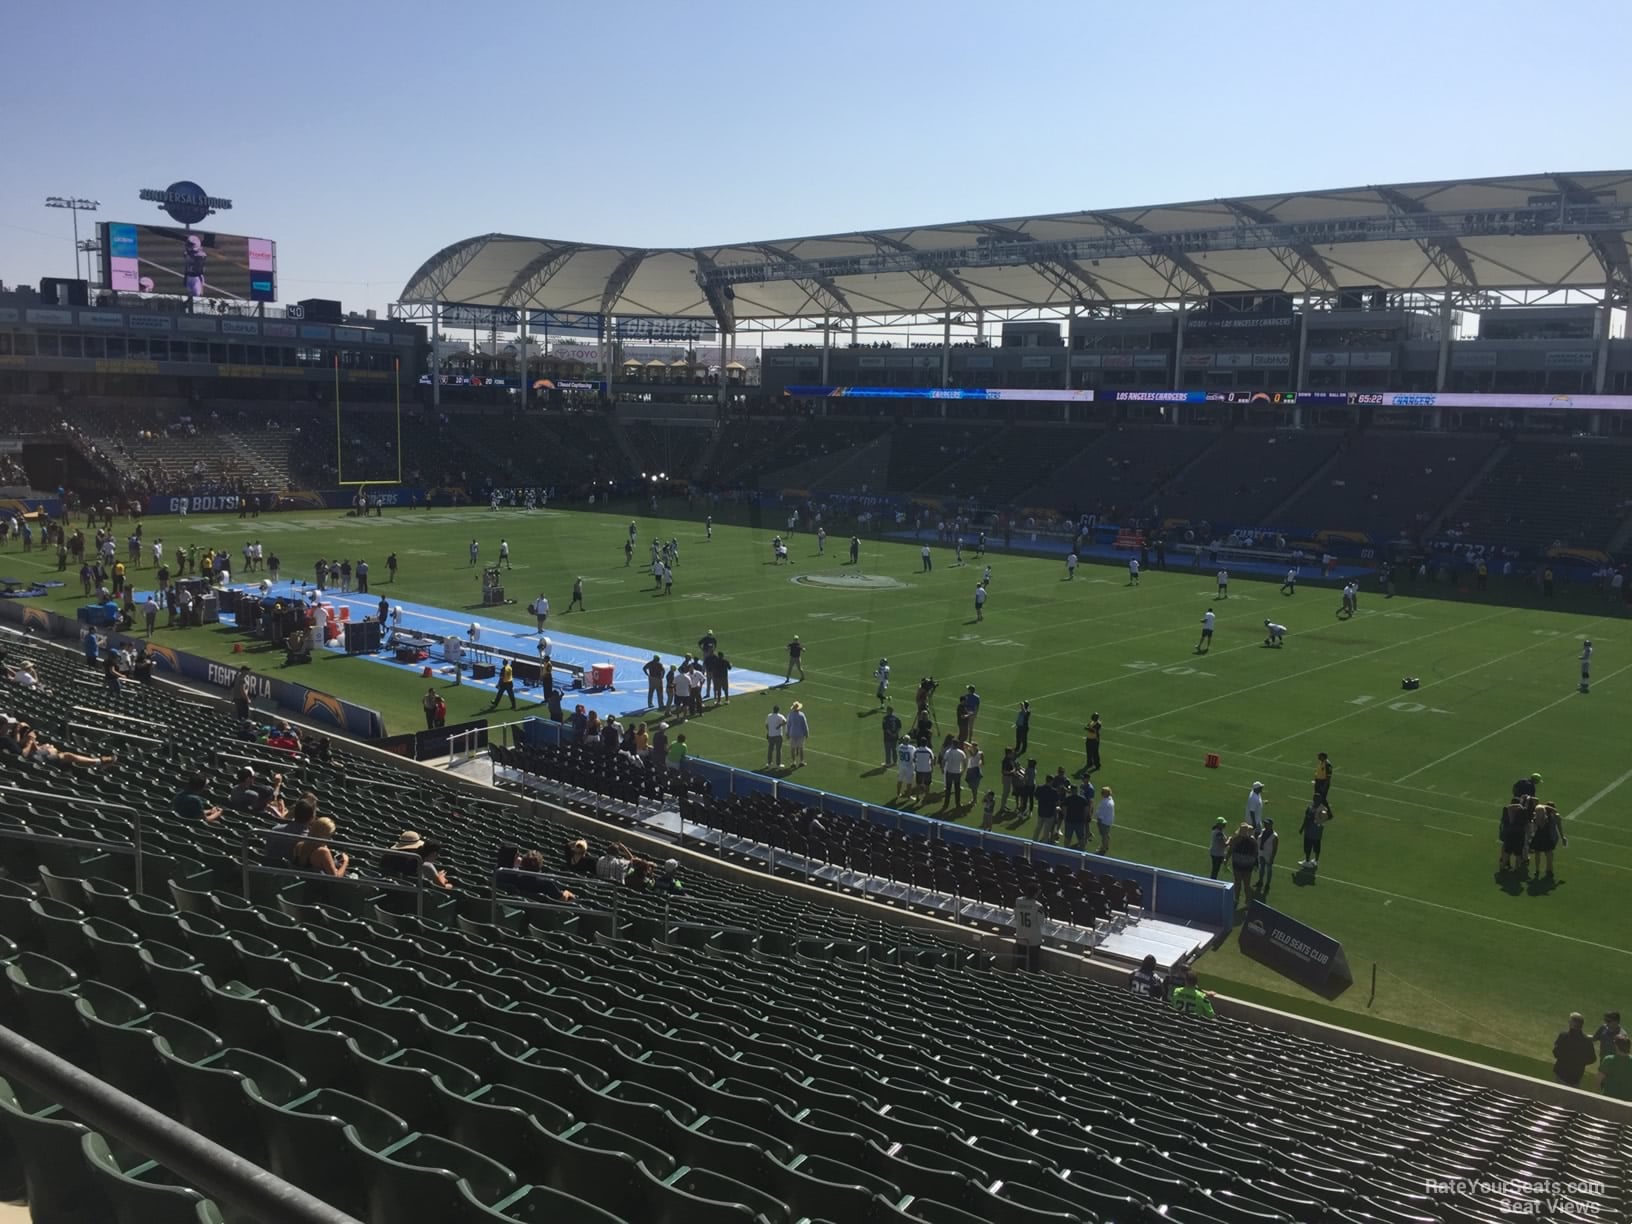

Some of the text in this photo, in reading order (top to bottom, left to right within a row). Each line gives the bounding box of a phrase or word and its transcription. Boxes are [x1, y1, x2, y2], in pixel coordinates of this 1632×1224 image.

[140, 189, 198, 205] UNIVERSAL
[198, 196, 232, 209] STUDIOS
[289, 306, 302, 318] 40
[1116, 392, 1188, 401] LOS ANGELES CHARGERS
[1358, 394, 1383, 404] 65:22
[192, 496, 240, 511] BOLTS!
[259, 678, 272, 699] LA
[1020, 912, 1032, 928] 16
[1271, 927, 1292, 945] FIELD
[1290, 936, 1311, 954] SEATS
[1310, 949, 1329, 965] CLUB
